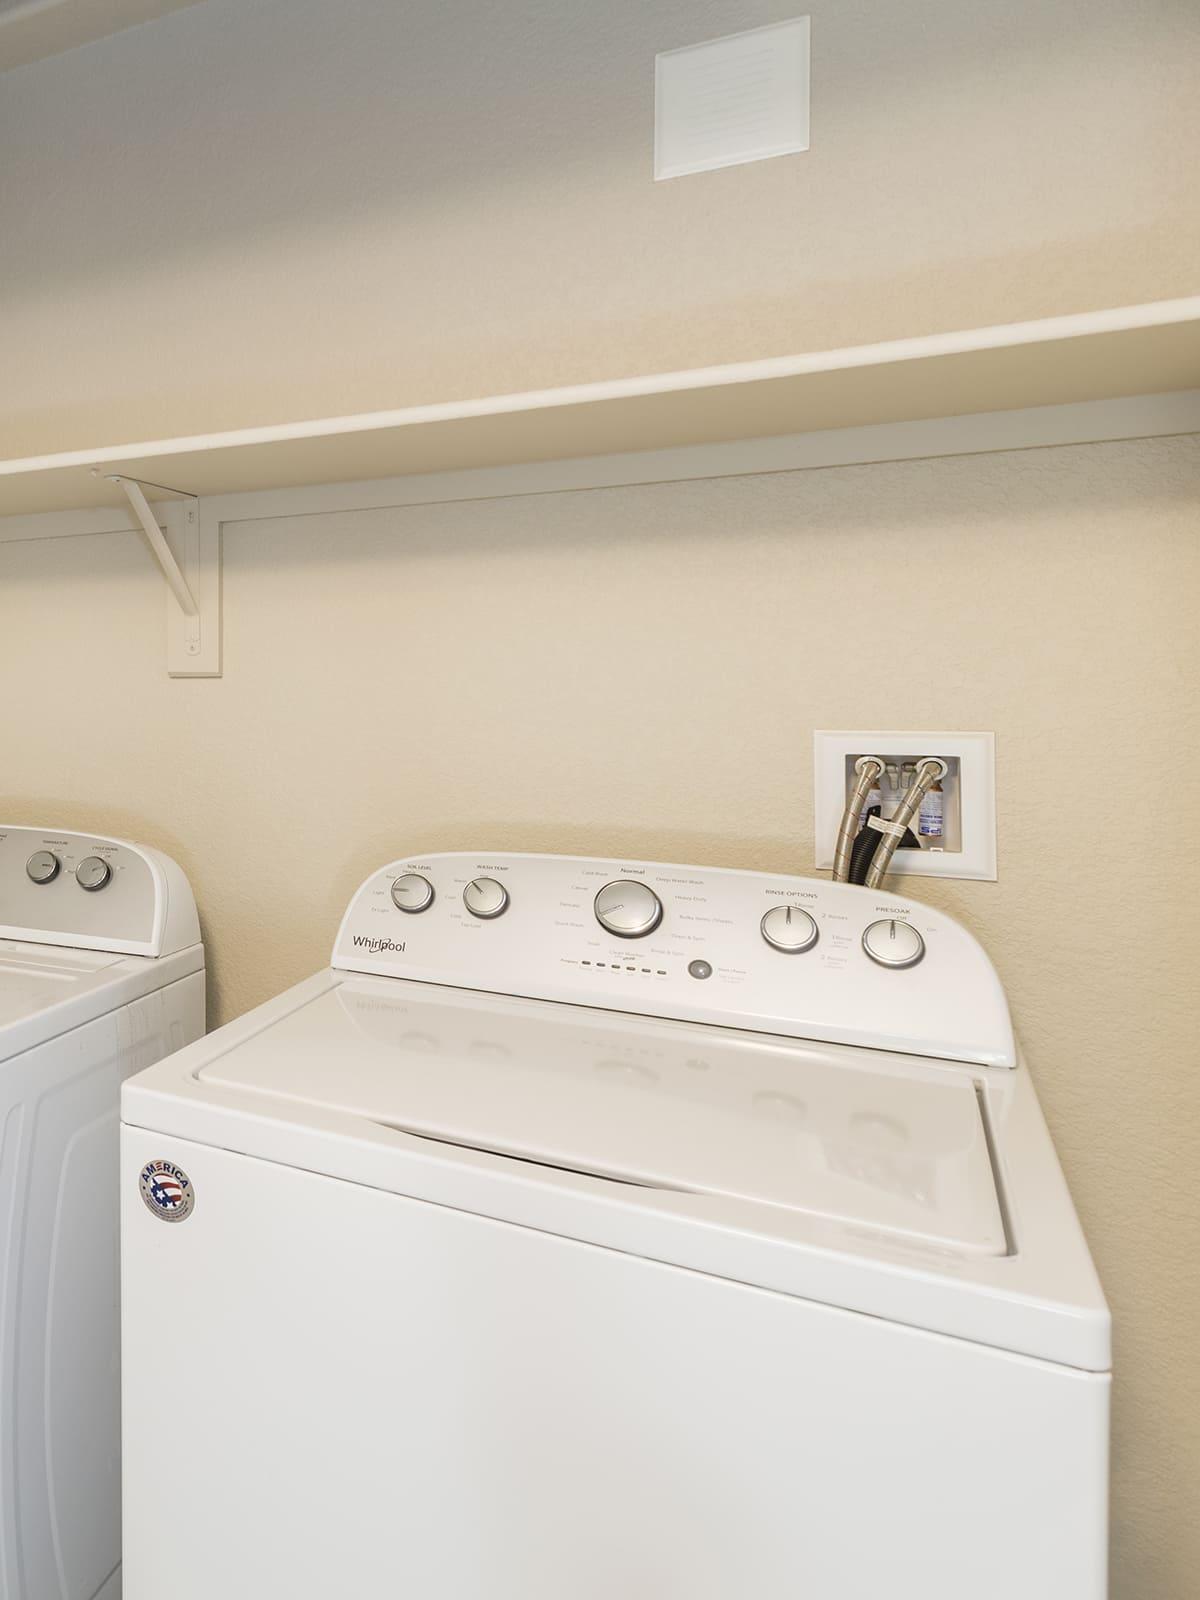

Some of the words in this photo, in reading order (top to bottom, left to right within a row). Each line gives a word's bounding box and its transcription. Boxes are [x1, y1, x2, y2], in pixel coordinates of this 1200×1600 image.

[786, 890, 819, 899] OPTIONS
[875, 906, 912, 914] PRESOAK
[352, 935, 406, 954] Whirlpool
[141, 1161, 189, 1189] AMERICA
